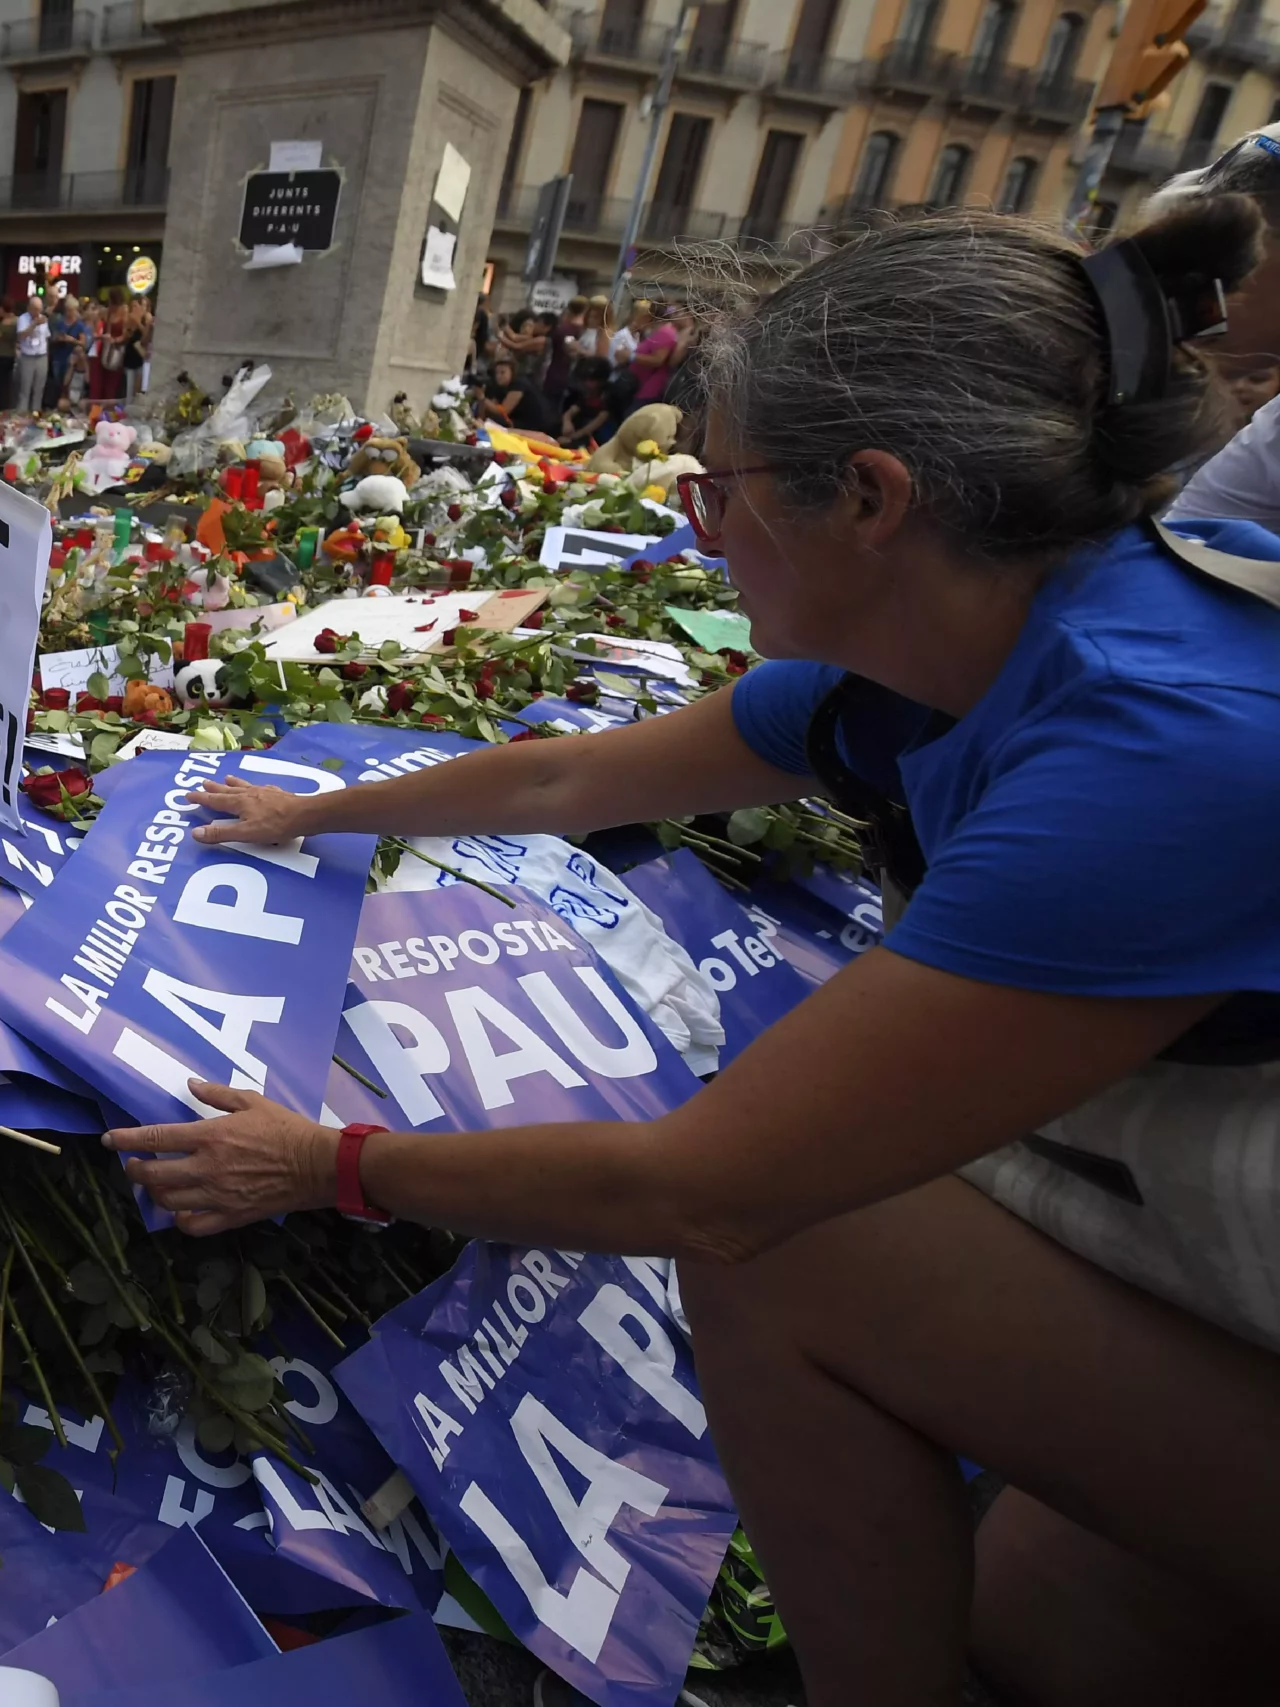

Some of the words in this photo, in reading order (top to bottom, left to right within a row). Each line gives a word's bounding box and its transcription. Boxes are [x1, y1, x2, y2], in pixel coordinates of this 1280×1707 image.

[252, 204, 321, 217] DIFERENTS
[269, 187, 309, 199] JUNTS
[126, 751, 226, 885] RESPOSTA
[73, 883, 158, 988] MILLOR
[352, 920, 577, 984] RESPOSTA
[45, 979, 108, 1034] LA
[343, 966, 658, 1128] PAU
[438, 1249, 571, 1415] MILLOR
[459, 1391, 670, 1665] LA
